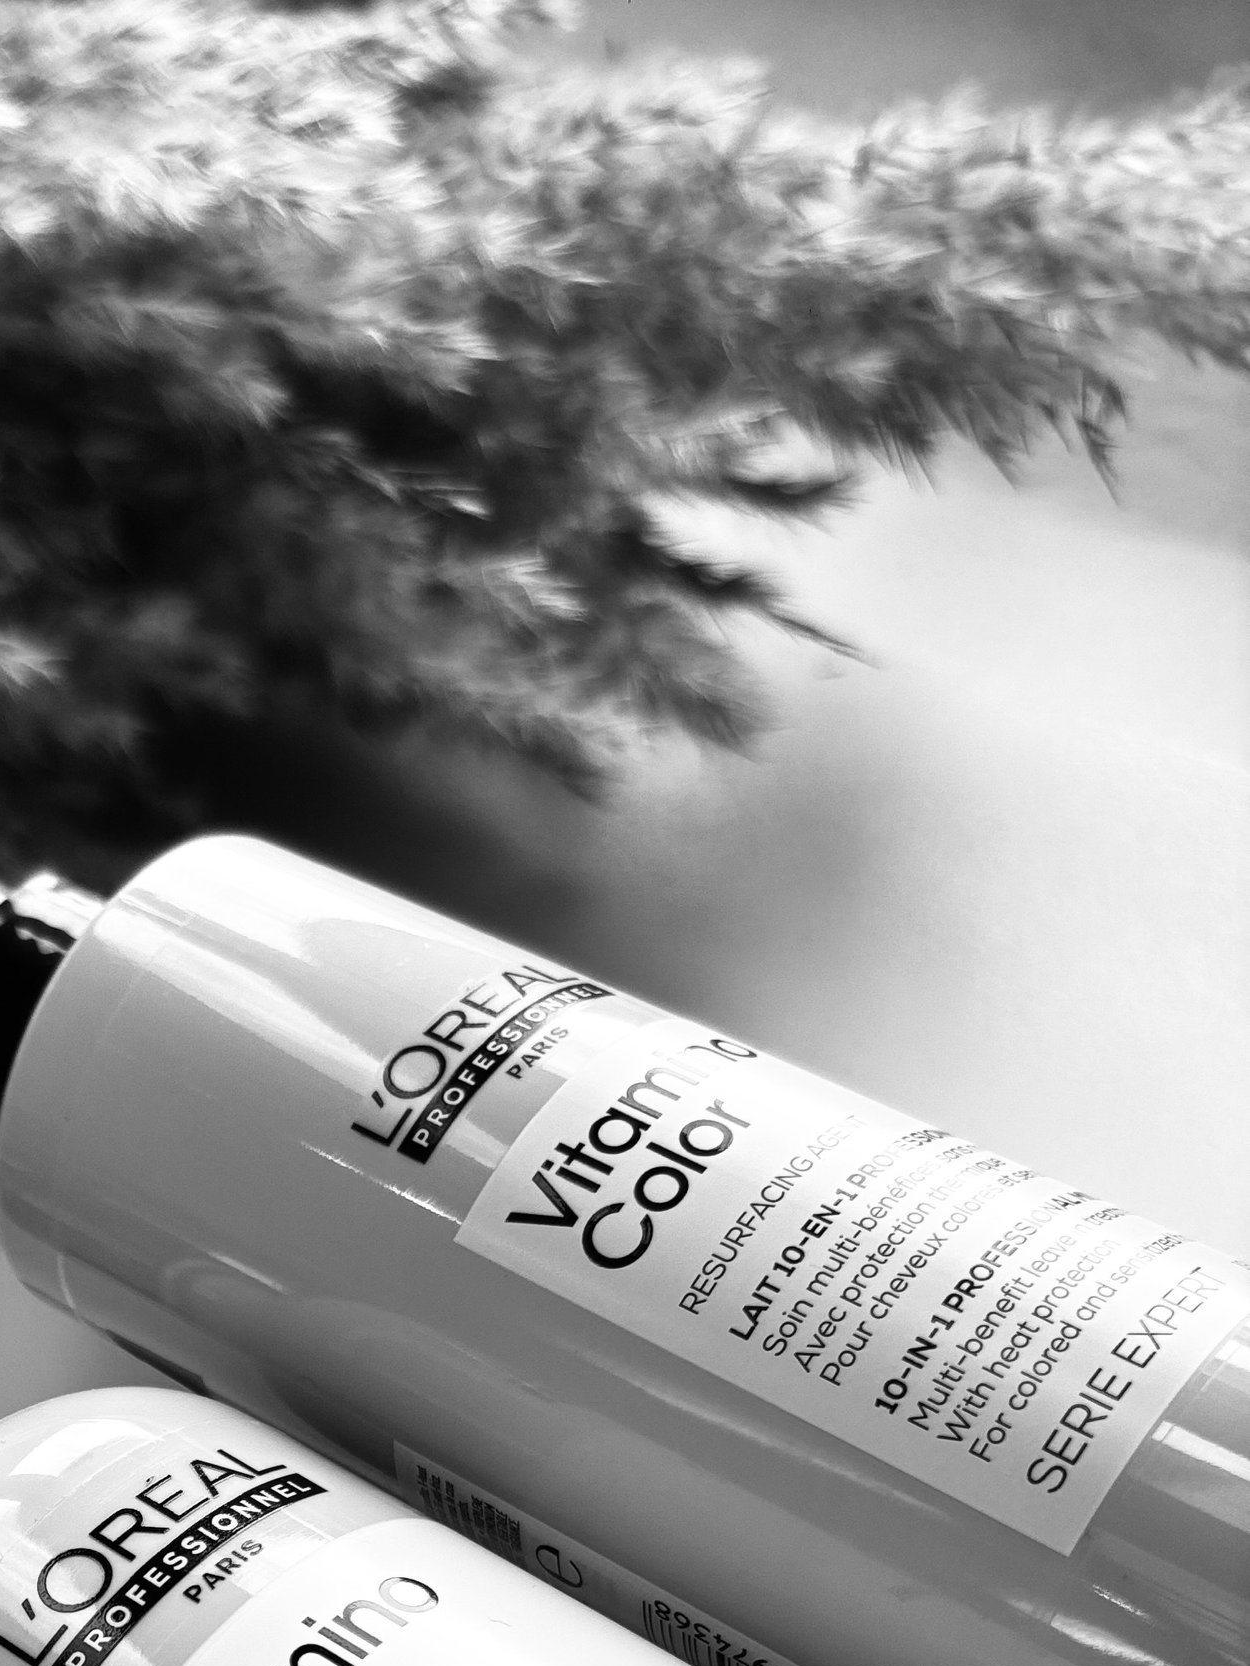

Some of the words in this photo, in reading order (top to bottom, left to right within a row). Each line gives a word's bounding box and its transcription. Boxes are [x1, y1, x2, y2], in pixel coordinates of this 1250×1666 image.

[413, 984, 603, 1150] PROFESSIONNEL
[507, 1025, 569, 1080] PARIS
[581, 1098, 752, 1270] Color
[679, 1154, 814, 1316] RESURFACING
[729, 1275, 783, 1341] LAIT
[772, 1186, 858, 1281] 10-EN-1
[762, 1296, 814, 1357] Soin
[793, 1303, 848, 1374] Avec
[840, 1200, 937, 1311] protection
[819, 1330, 873, 1388] Pour
[870, 1231, 950, 1321] cheveux
[874, 1310, 954, 1416] 10-IN-1
[907, 1274, 1036, 1431] Multi-benefit
[937, 1376, 998, 1446] With
[987, 1321, 1040, 1395] heat
[1031, 1237, 1123, 1326] protection
[969, 1413, 1013, 1464] For
[1009, 1316, 1084, 1411] colored
[1076, 1282, 1118, 1321] and
[1027, 1369, 1133, 1493] SERIE
[1110, 1265, 1228, 1372] EXPERT
[182, 1539, 265, 1604] PARIS
